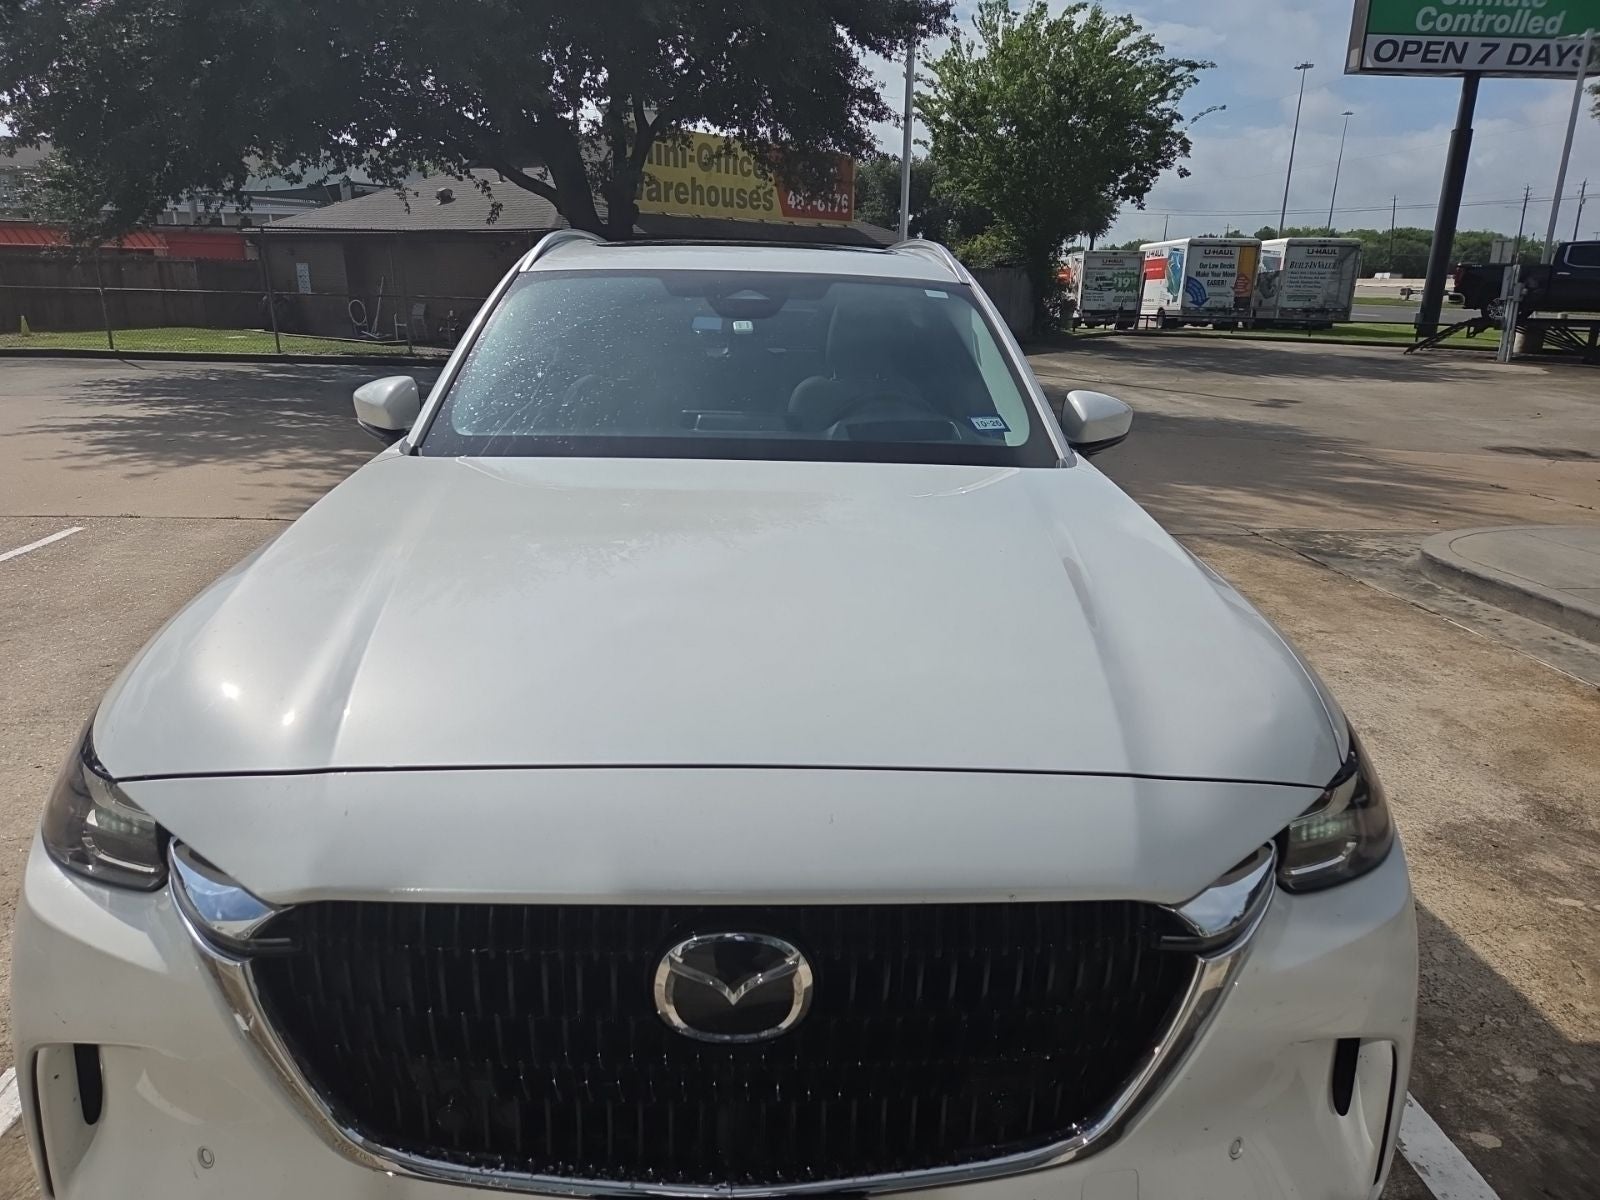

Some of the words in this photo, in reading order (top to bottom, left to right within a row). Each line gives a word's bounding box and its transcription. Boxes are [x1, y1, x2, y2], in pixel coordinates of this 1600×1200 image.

[1416, 7, 1565, 34] Controlled
[1373, 39, 1469, 64] OPEN
[1477, 42, 1500, 65] 7
[1207, 279, 1227, 287] EASIER!
